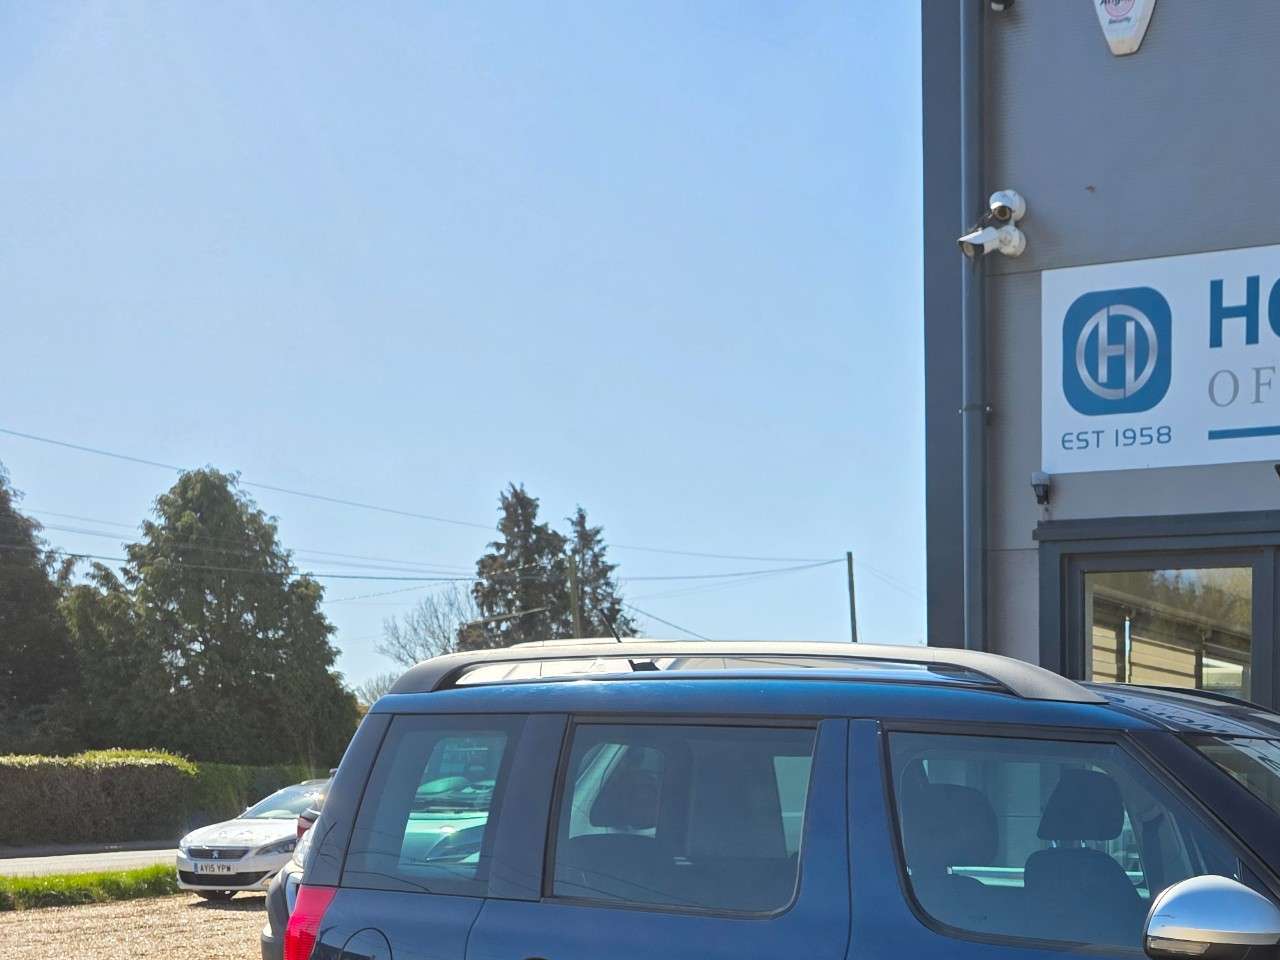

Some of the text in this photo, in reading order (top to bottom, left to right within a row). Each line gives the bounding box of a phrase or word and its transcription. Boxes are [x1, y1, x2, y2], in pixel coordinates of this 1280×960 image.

[1208, 366, 1276, 408] OF
[1061, 426, 1172, 450] EST 1958
